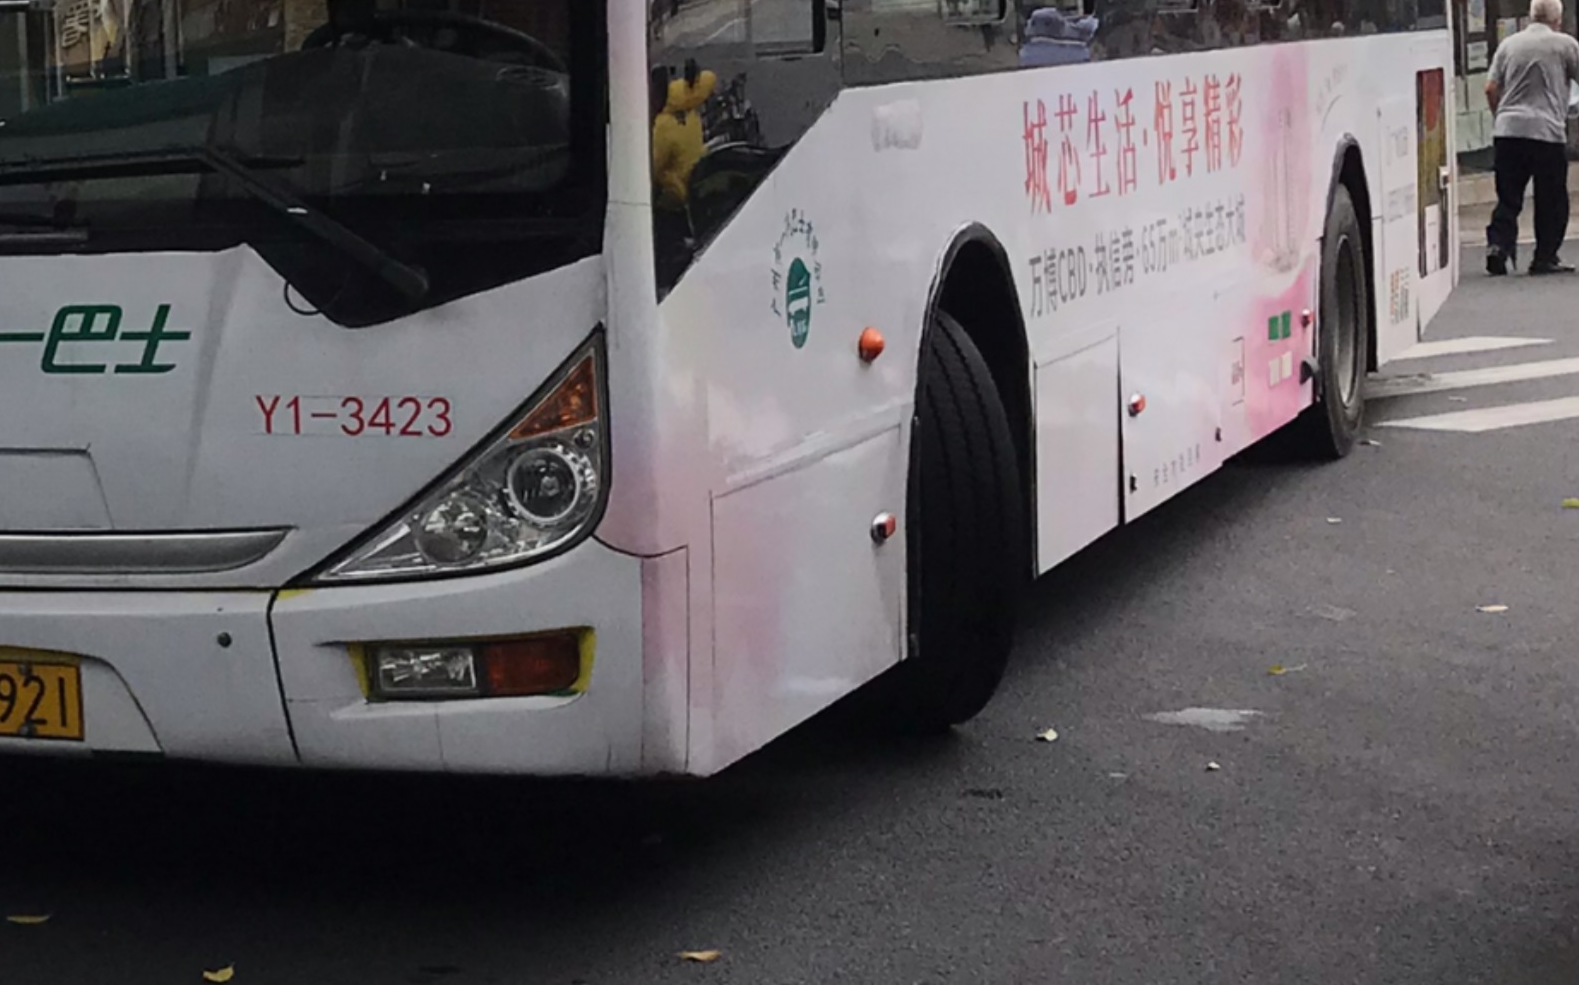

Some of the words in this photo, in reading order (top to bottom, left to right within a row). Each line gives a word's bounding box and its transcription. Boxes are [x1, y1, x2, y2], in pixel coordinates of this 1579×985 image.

[1022, 72, 1244, 215] 城芯生活·悦享精彩
[254, 395, 452, 437] Y1-3423
